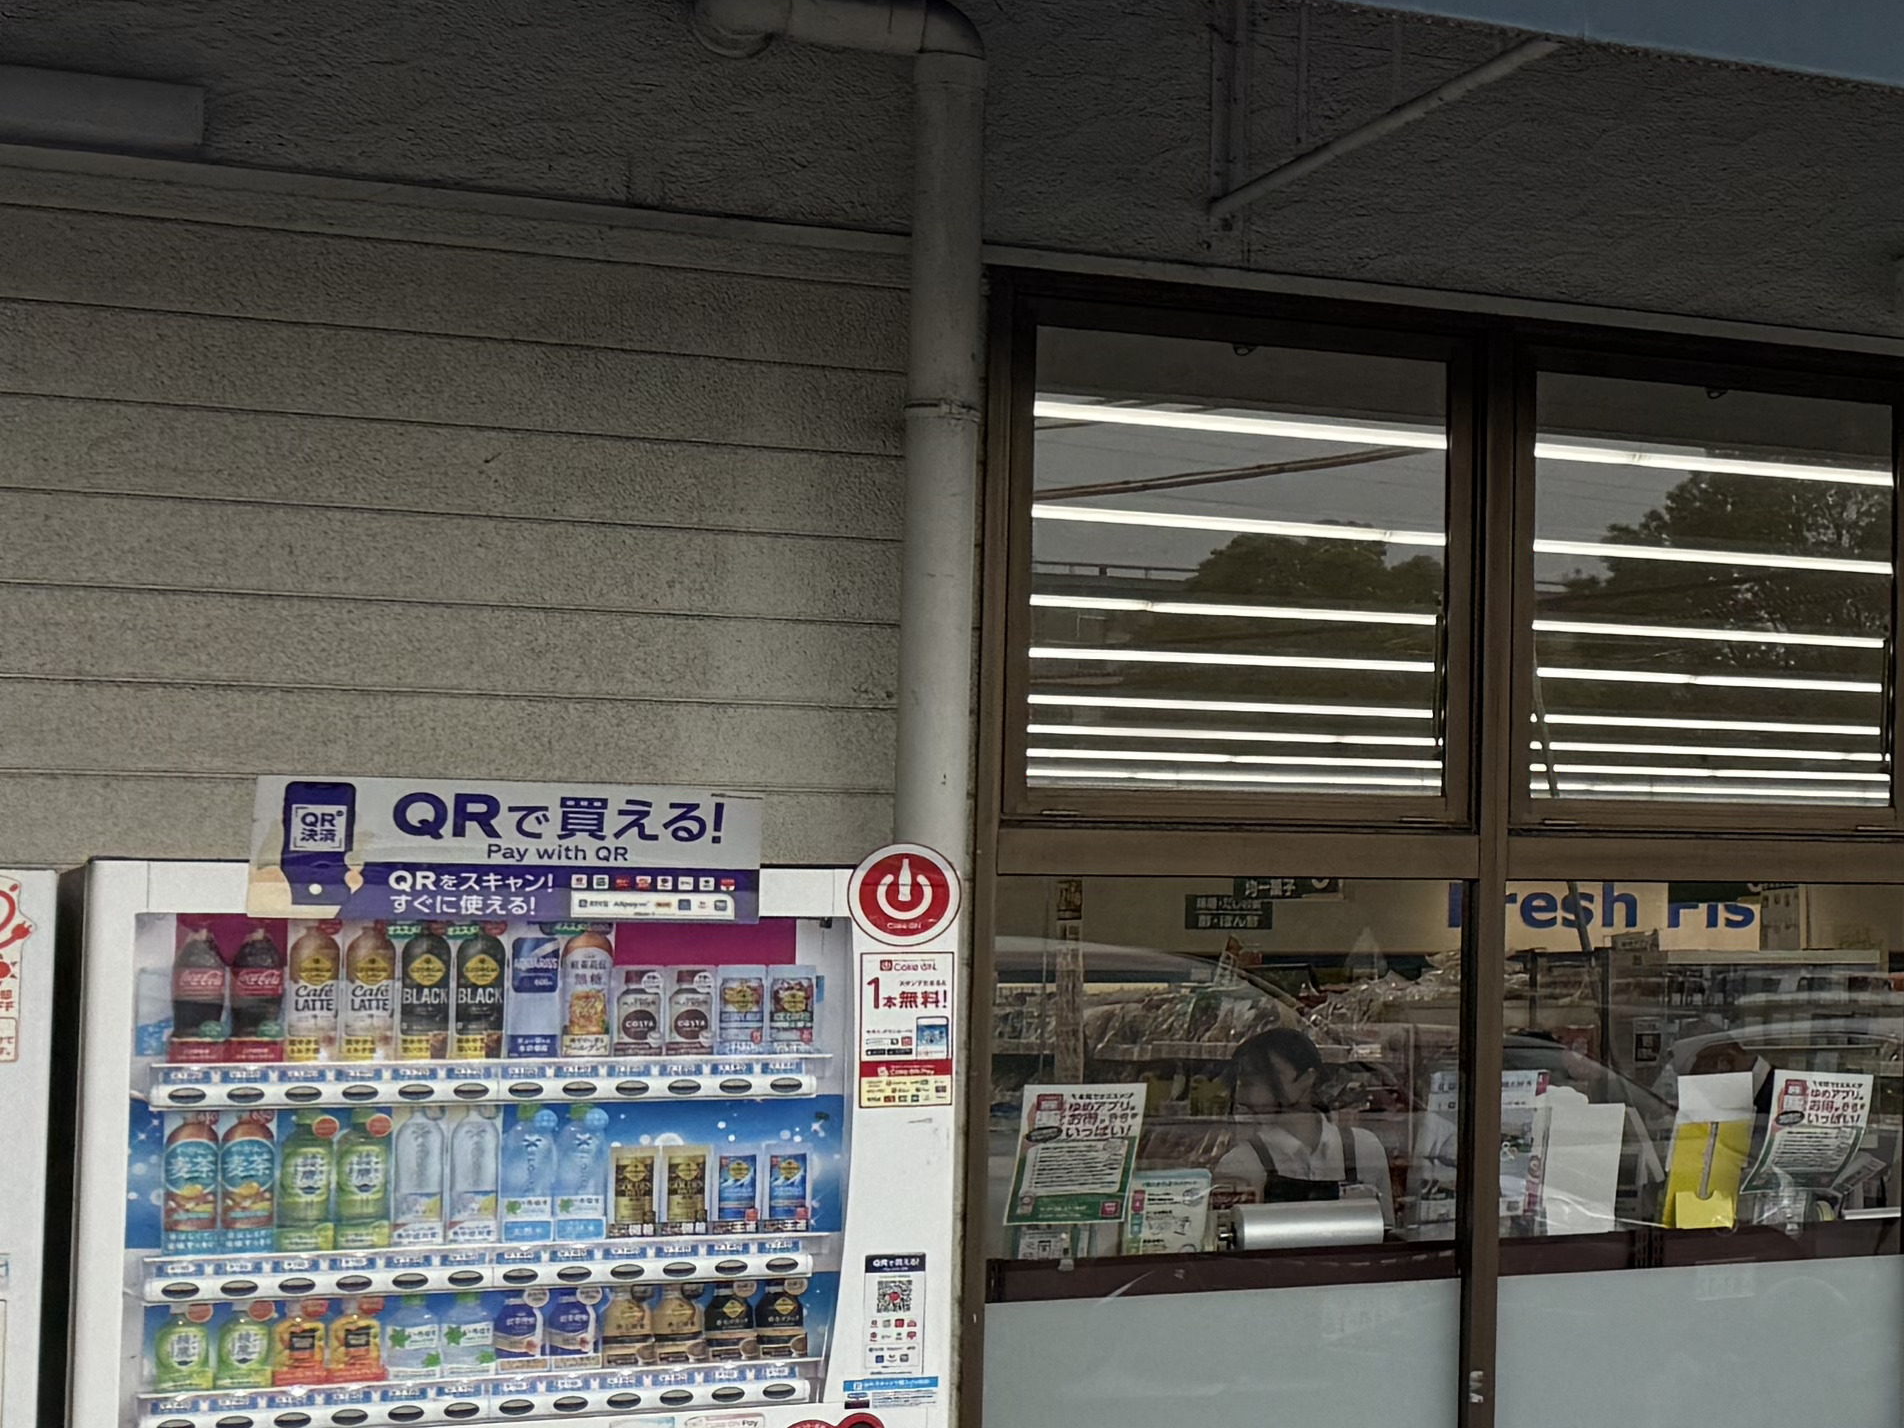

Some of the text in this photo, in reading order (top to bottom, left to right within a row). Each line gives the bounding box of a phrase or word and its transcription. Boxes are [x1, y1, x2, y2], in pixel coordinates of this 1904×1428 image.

[300, 811, 337, 828] QR
[393, 791, 724, 844] QRで買える!
[300, 828, 337, 842] 決済
[487, 844, 629, 863] Pay with QR
[388, 870, 554, 893] QRをスキャン!
[390, 894, 537, 916] すぐに使える!
[294, 984, 334, 999] Café
[351, 984, 390, 999] Café
[402, 987, 449, 1005] BLACK
[457, 987, 503, 1005] BLACK
[866, 976, 948, 1010] 1本無料!
[294, 998, 334, 1013] LATTE
[350, 998, 390, 1013] LATTE
